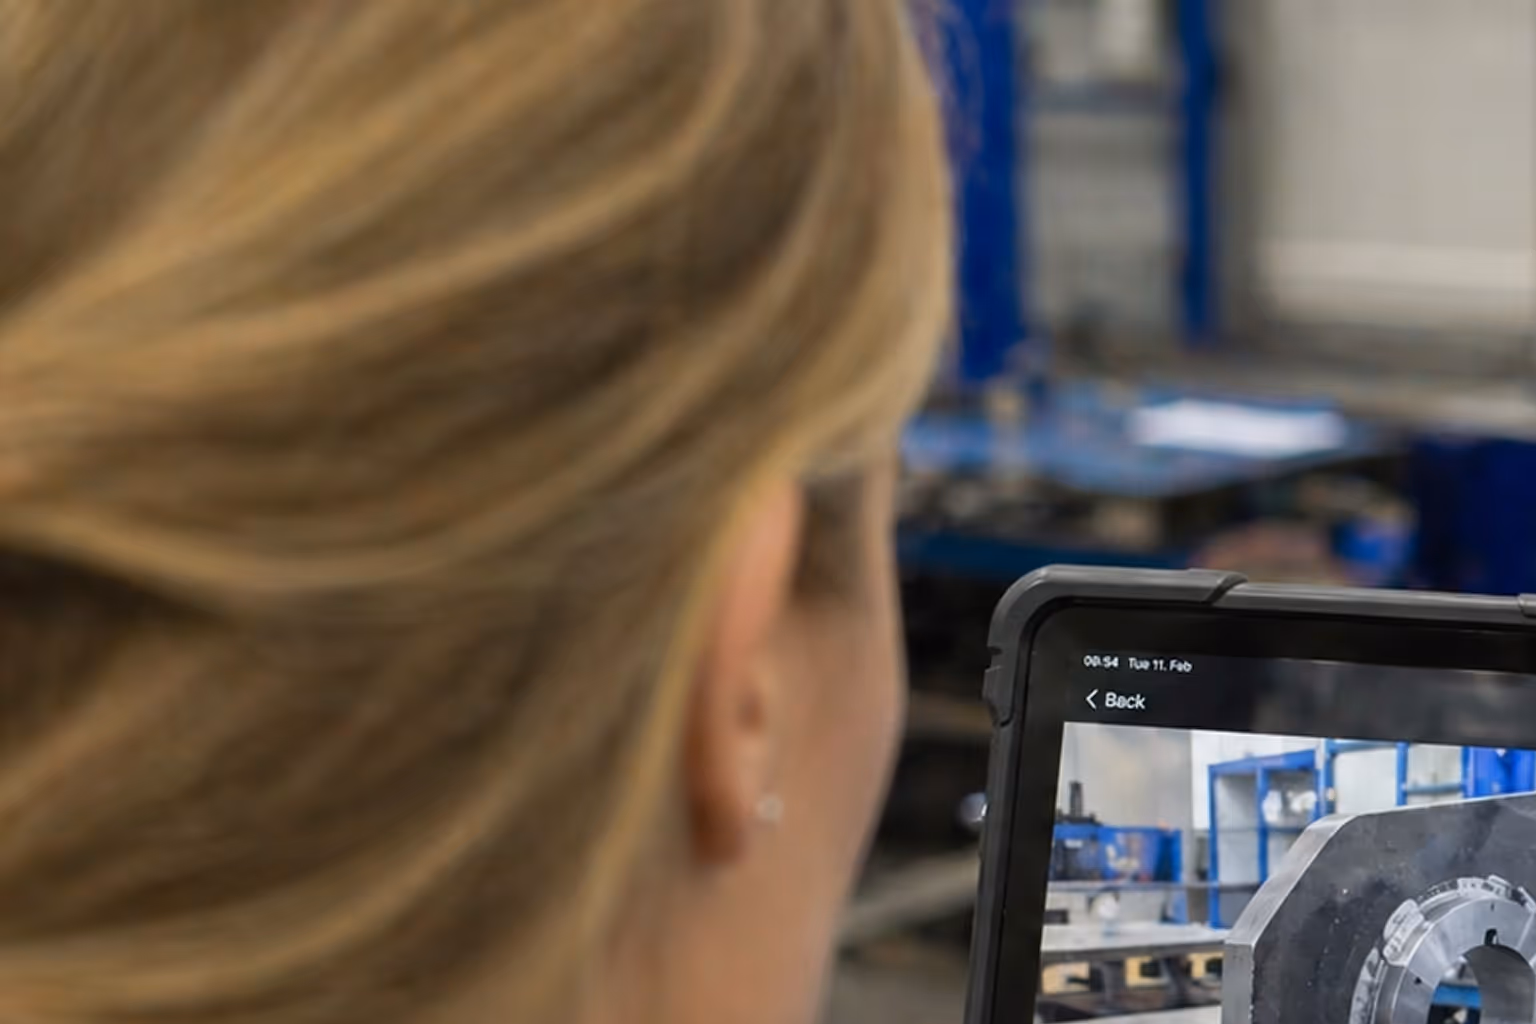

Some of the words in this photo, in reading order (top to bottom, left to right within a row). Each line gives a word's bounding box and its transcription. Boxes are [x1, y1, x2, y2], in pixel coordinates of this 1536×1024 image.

[1128, 657, 1150, 670] Tue
[1169, 659, 1193, 673] Feb
[1104, 691, 1146, 709] Back
